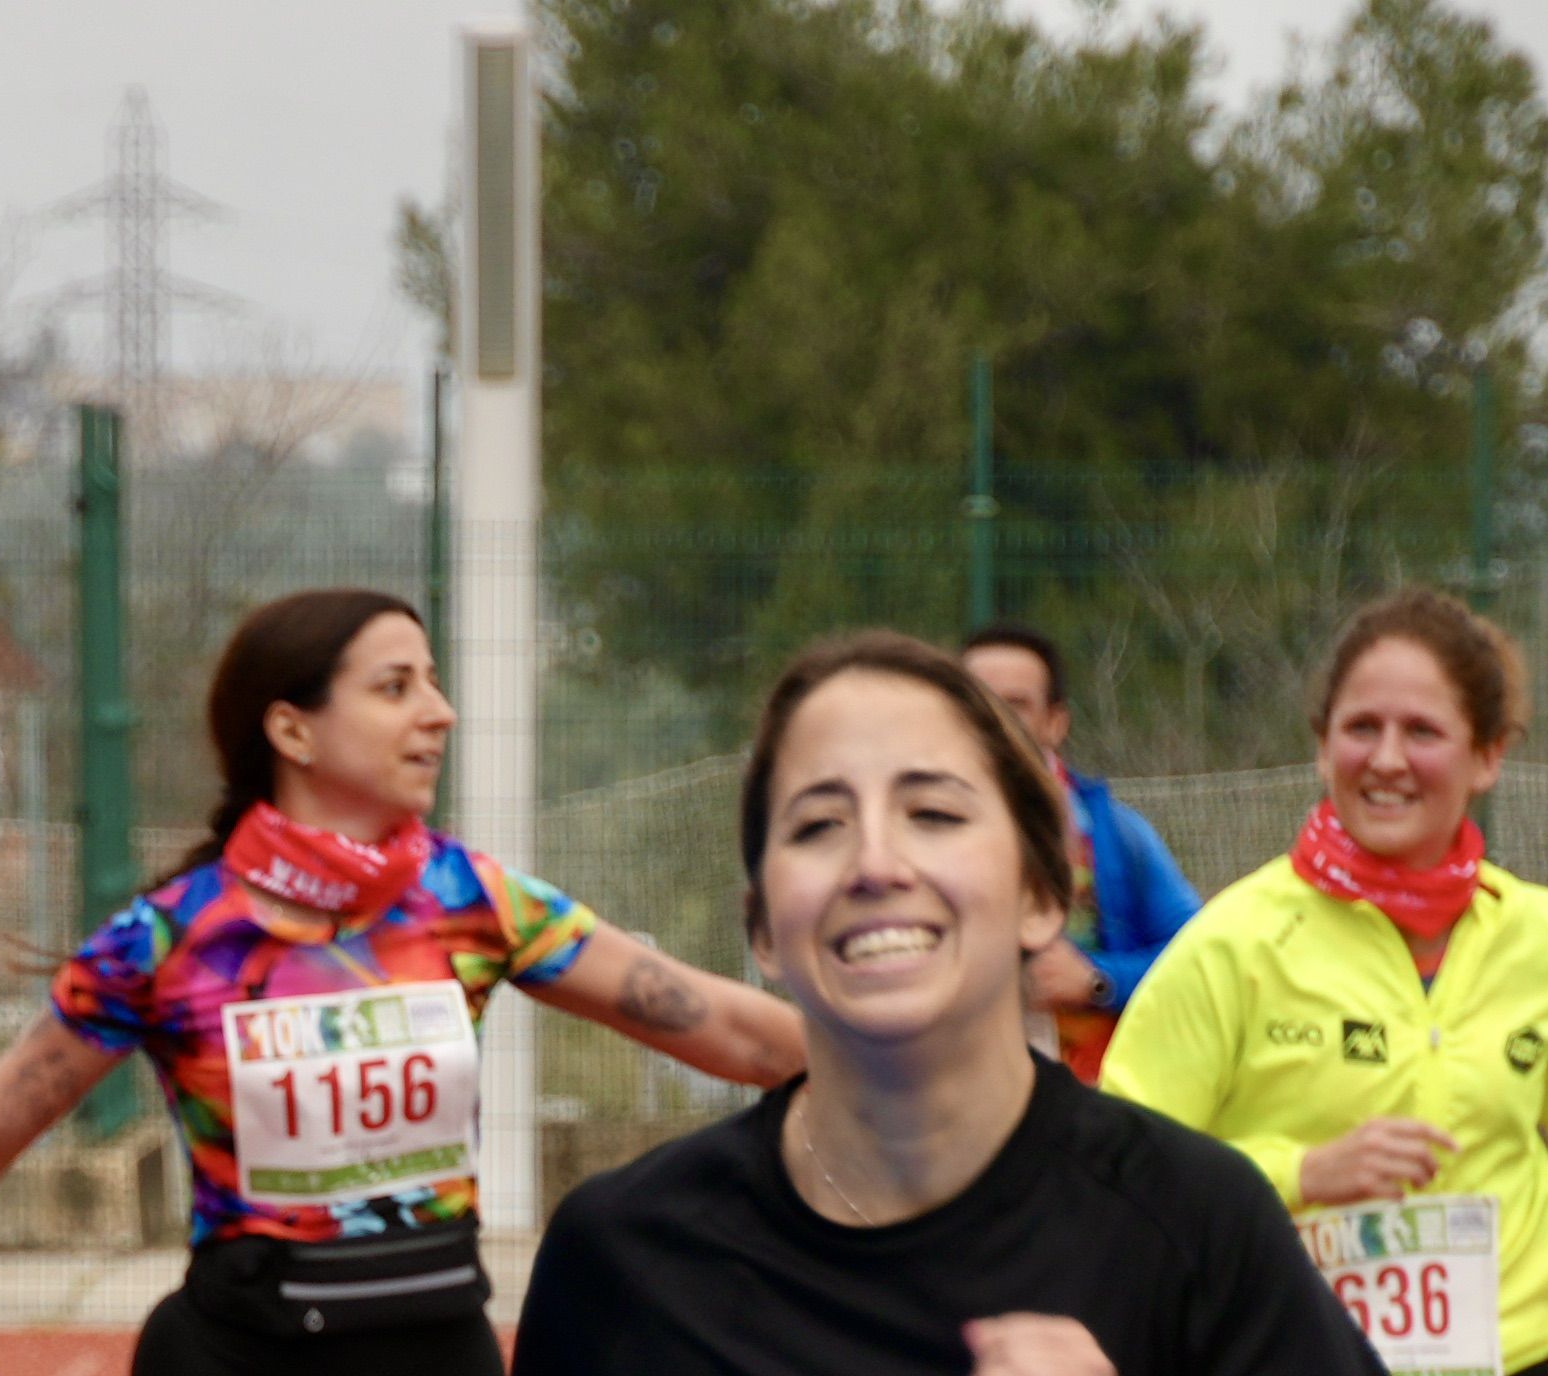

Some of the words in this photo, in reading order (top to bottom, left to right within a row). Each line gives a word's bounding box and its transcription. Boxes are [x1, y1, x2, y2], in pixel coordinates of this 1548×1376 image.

[249, 1008, 326, 1060] 10K
[271, 1053, 439, 1139] 1156
[1334, 1263, 1452, 1340] 636
